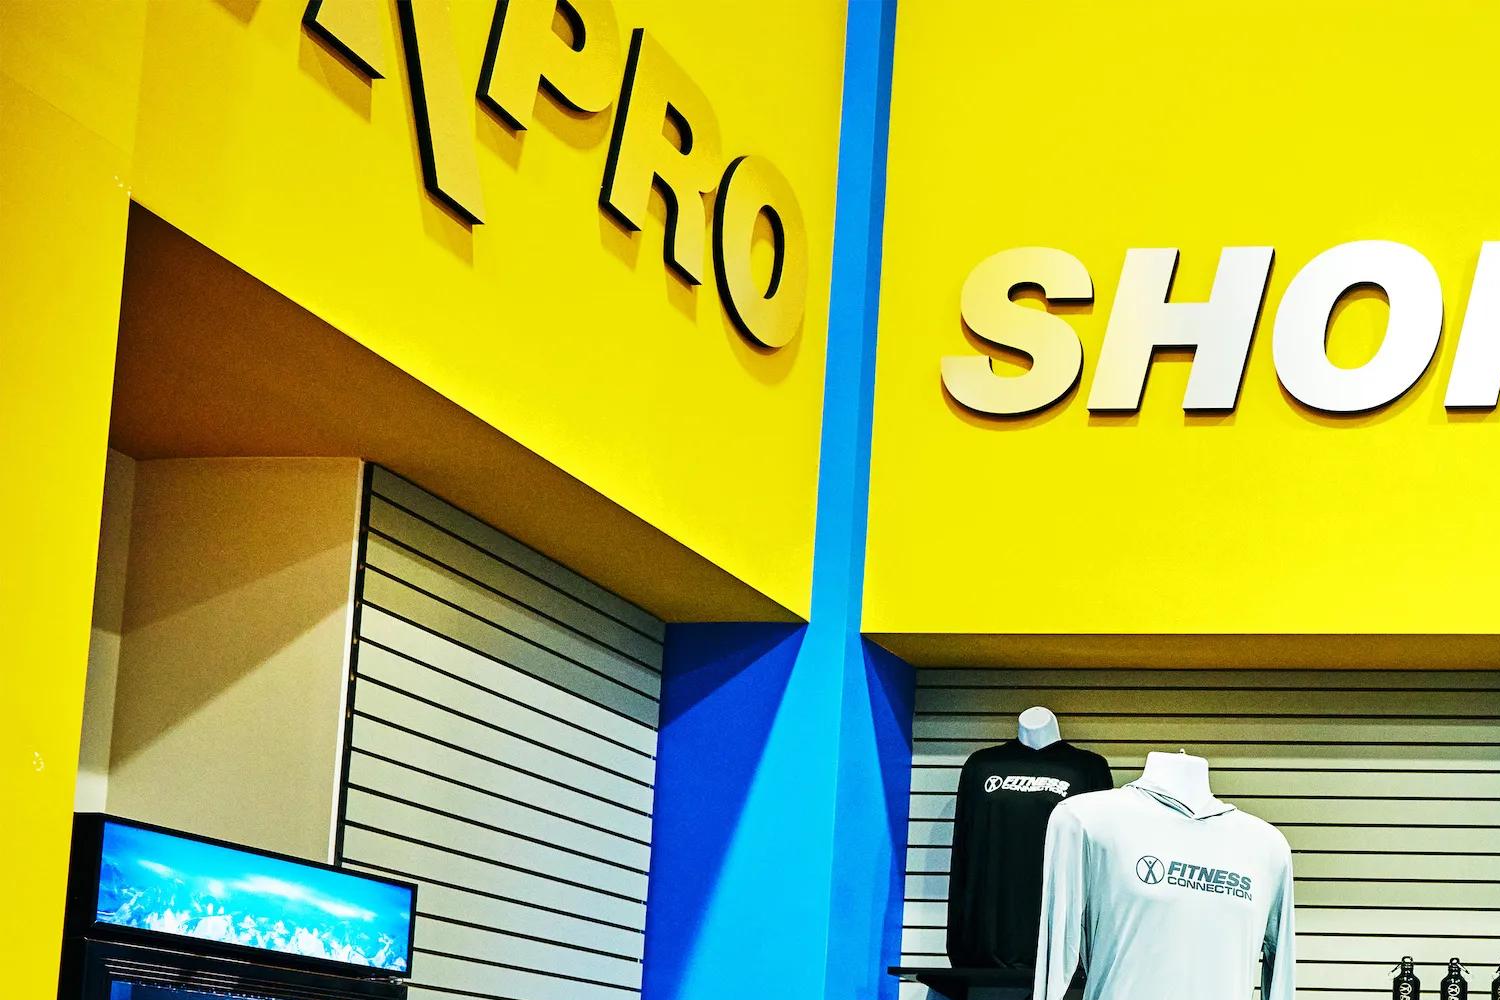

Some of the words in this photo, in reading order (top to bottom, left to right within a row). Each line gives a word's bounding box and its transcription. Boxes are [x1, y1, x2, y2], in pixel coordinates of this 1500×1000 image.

[1002, 775, 1071, 791] FITNESS
[1167, 861, 1252, 891] FITNESS
[1167, 876, 1253, 901] CONNECTION
